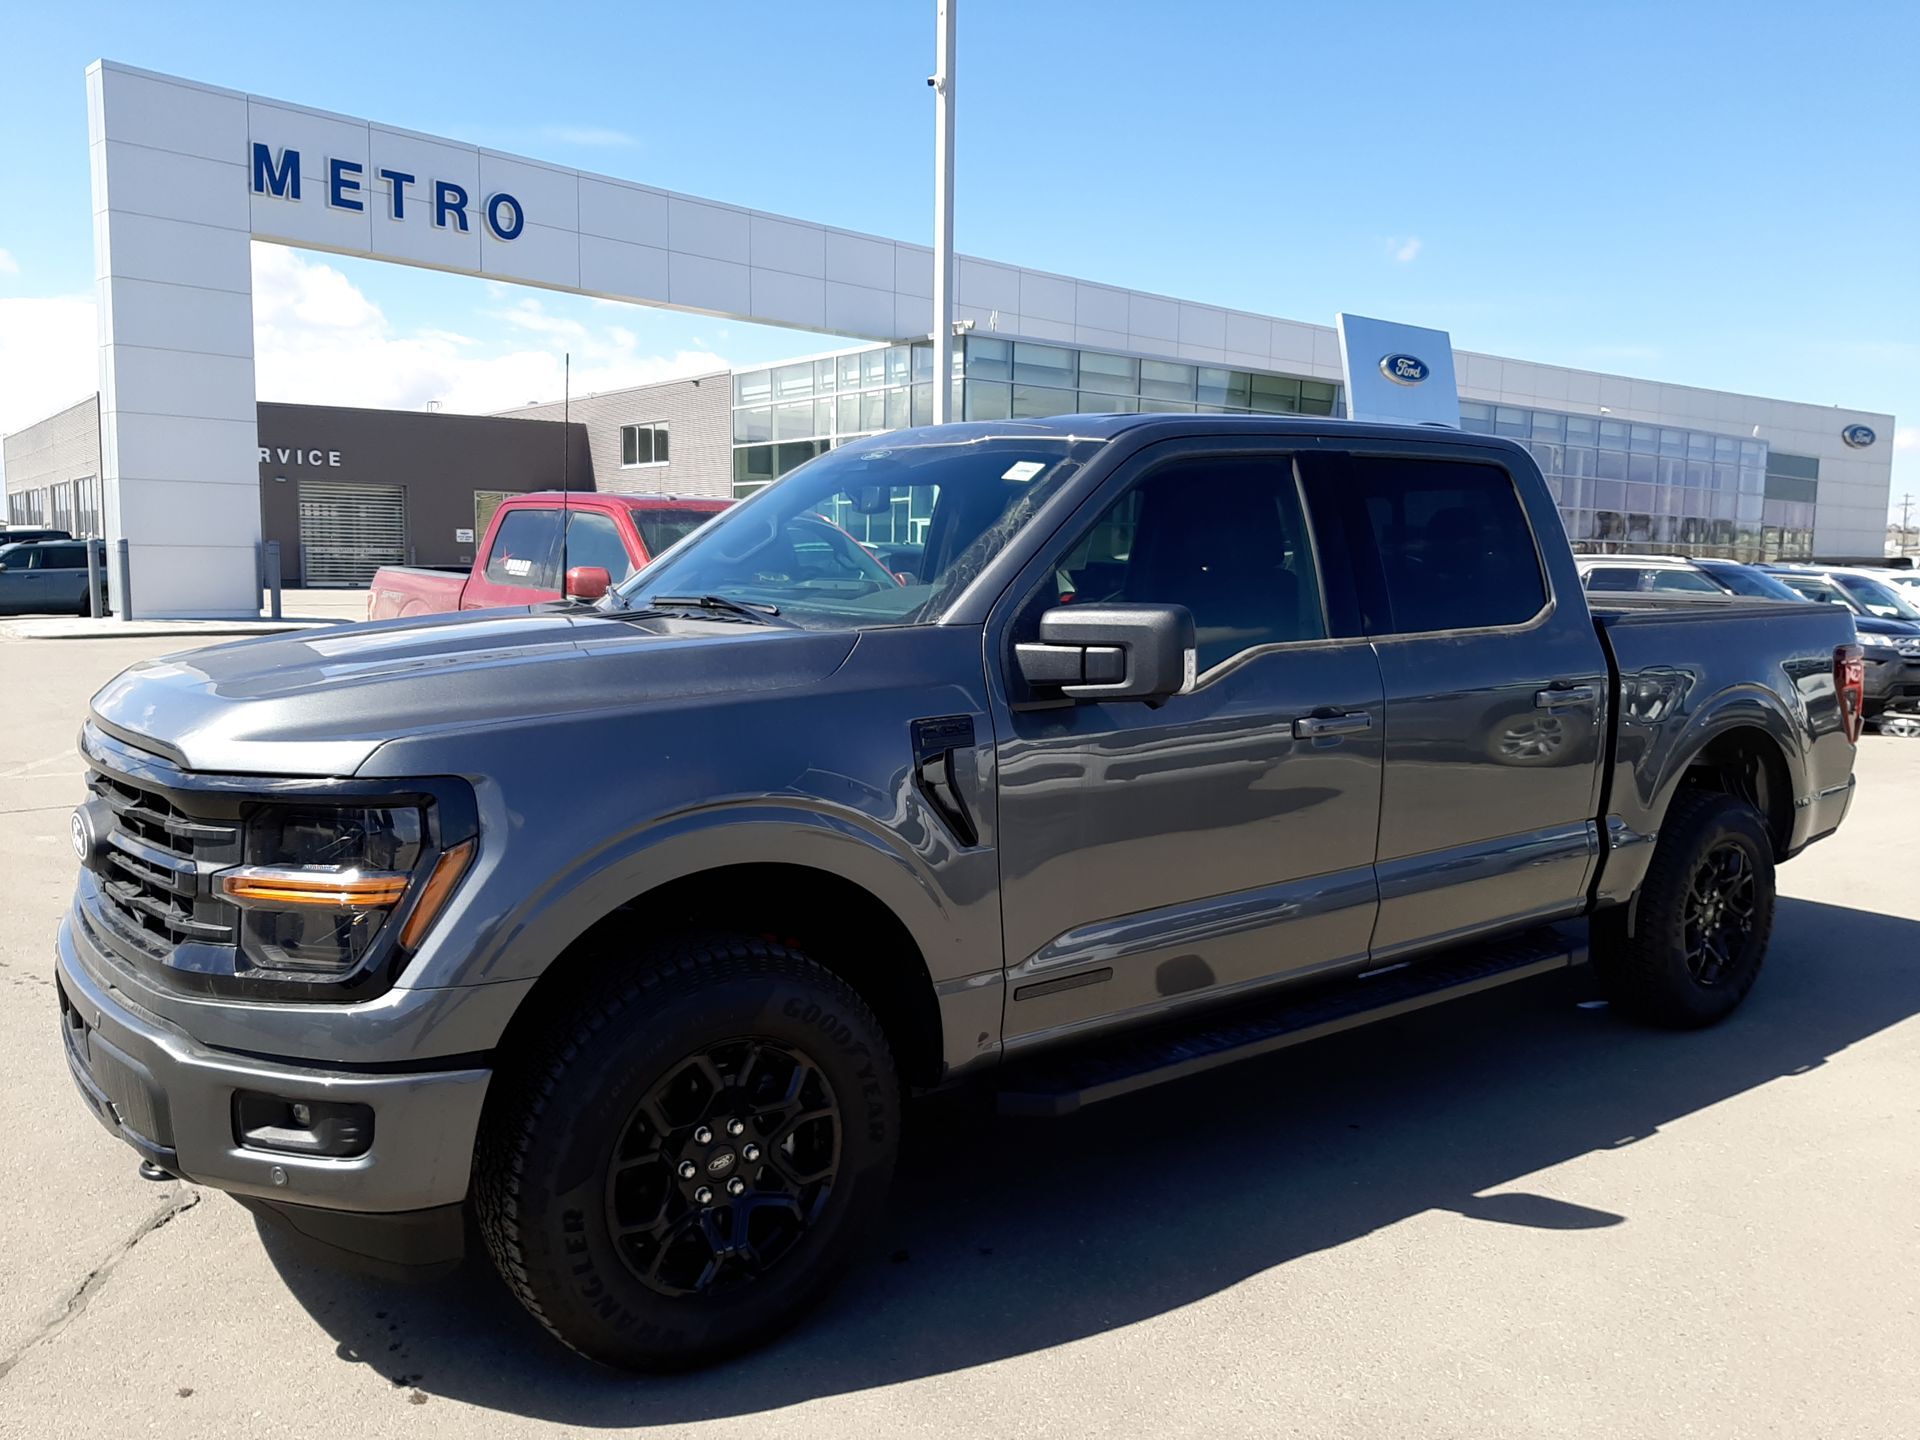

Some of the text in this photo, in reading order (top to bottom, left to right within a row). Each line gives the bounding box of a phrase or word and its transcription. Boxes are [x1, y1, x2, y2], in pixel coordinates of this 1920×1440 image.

[252, 141, 525, 241] METRO
[1396, 358, 1421, 378] Ford
[783, 998, 884, 1143] GOODYEAR
